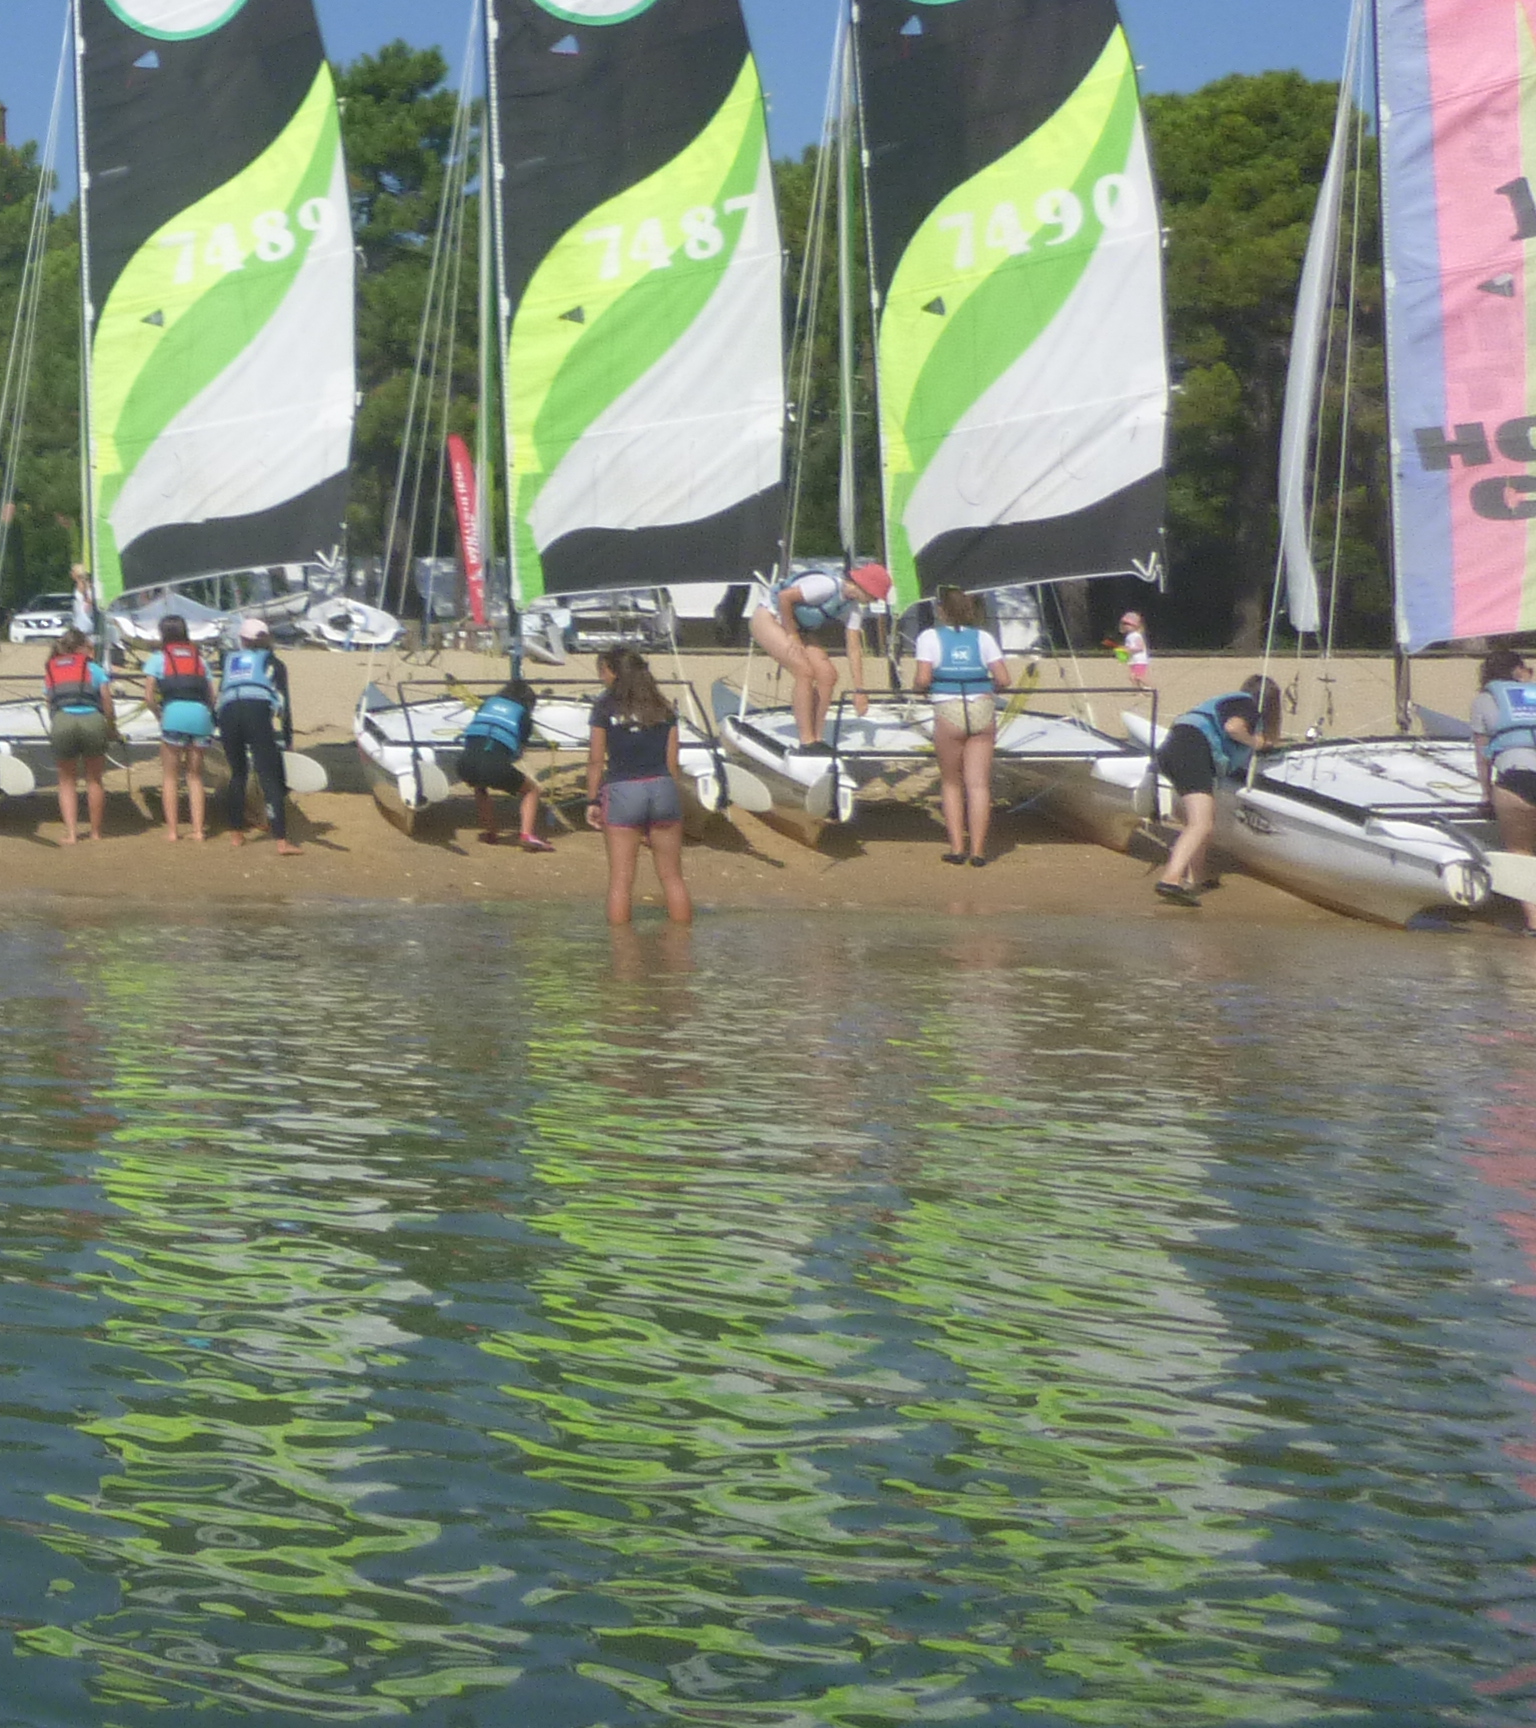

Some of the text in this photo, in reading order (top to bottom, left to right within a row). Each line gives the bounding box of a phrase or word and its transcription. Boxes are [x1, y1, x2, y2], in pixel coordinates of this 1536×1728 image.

[158, 197, 340, 286] 7489
[583, 192, 760, 281] 7487
[938, 173, 1139, 269] 7490
